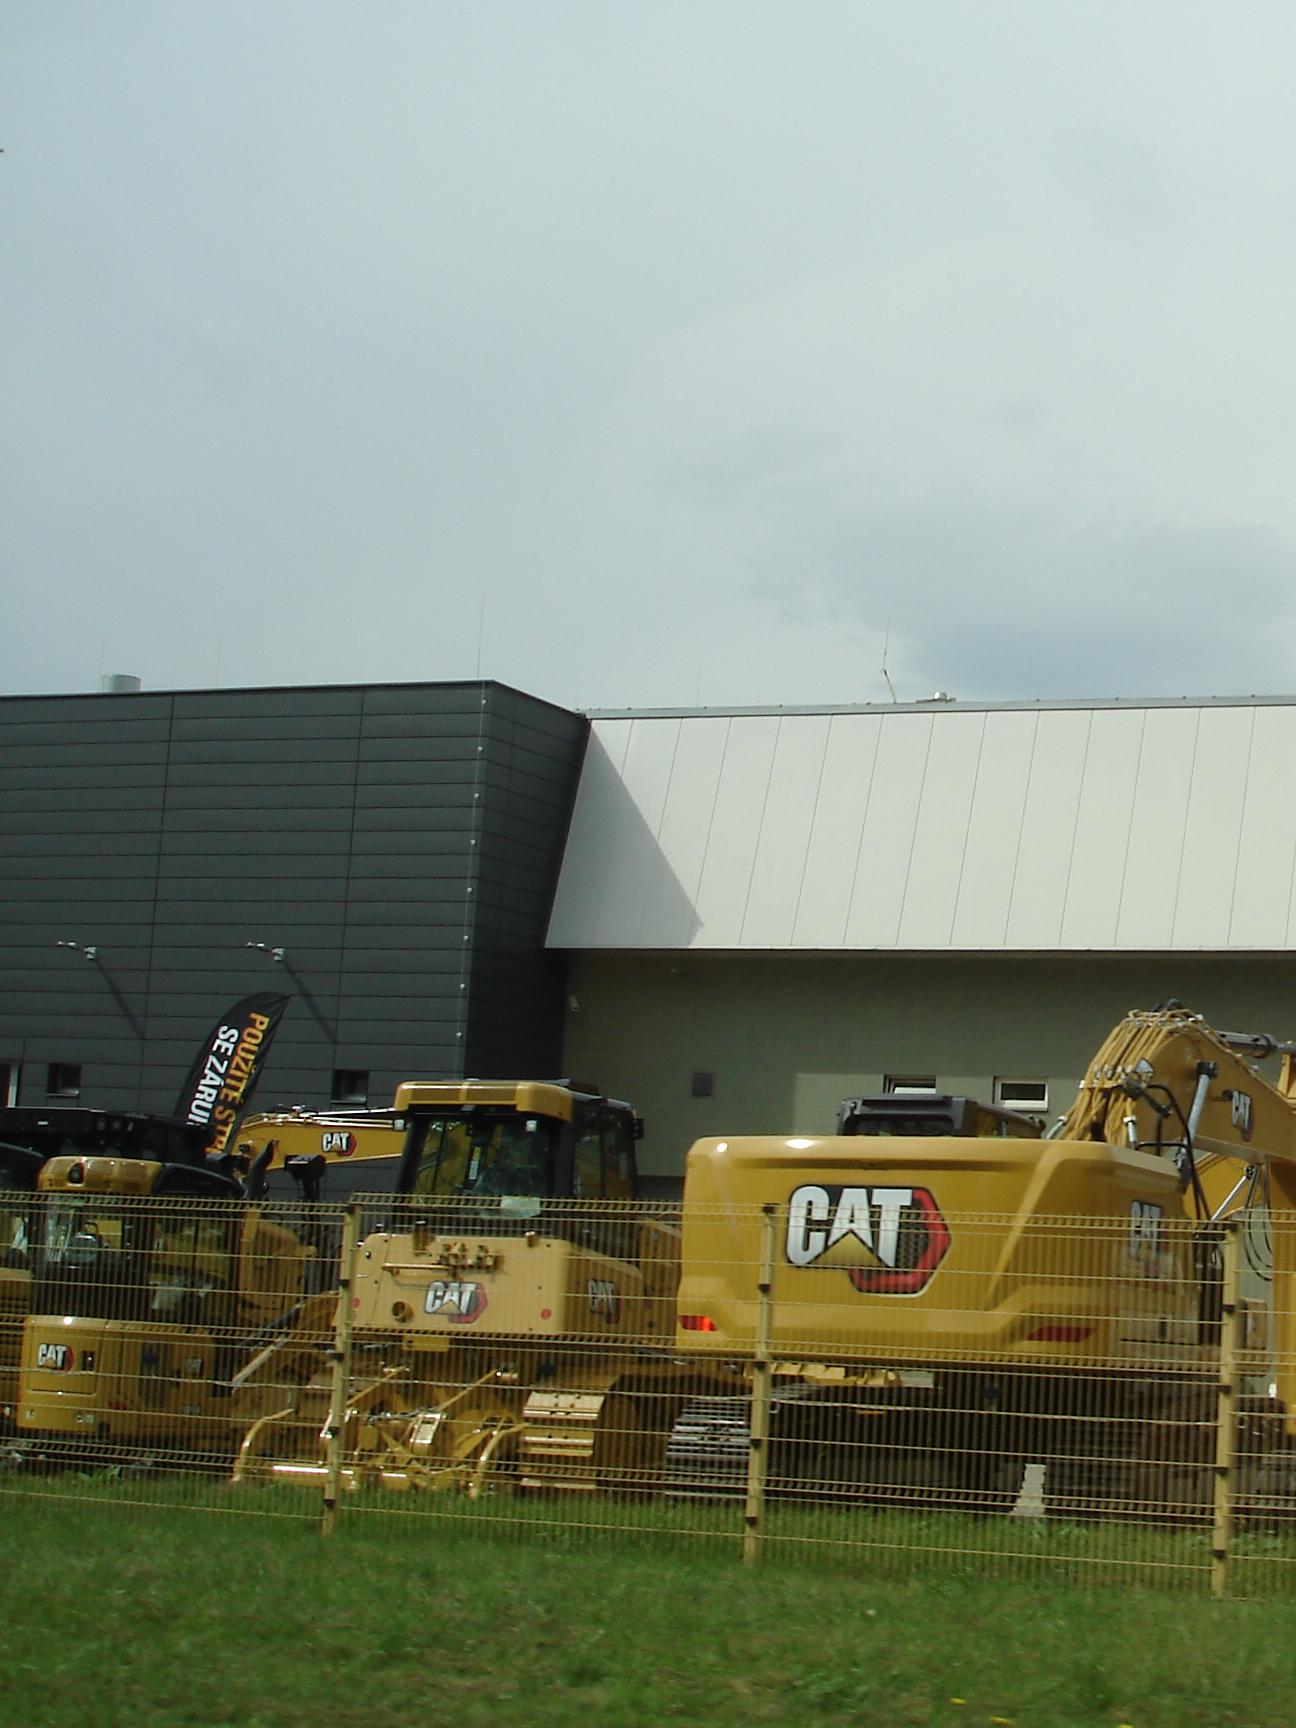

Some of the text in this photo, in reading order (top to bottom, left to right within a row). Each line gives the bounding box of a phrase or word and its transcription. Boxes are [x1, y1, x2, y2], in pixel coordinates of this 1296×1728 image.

[211, 1025, 240, 1057] SE
[219, 1011, 272, 1106] POUŽITÉ
[1231, 1090, 1252, 1130] CAT
[322, 1132, 350, 1153] CAT
[786, 1185, 913, 1268] CAT
[424, 1280, 478, 1315] CAT
[587, 1279, 616, 1314] CAT
[37, 1343, 68, 1368] CAT
